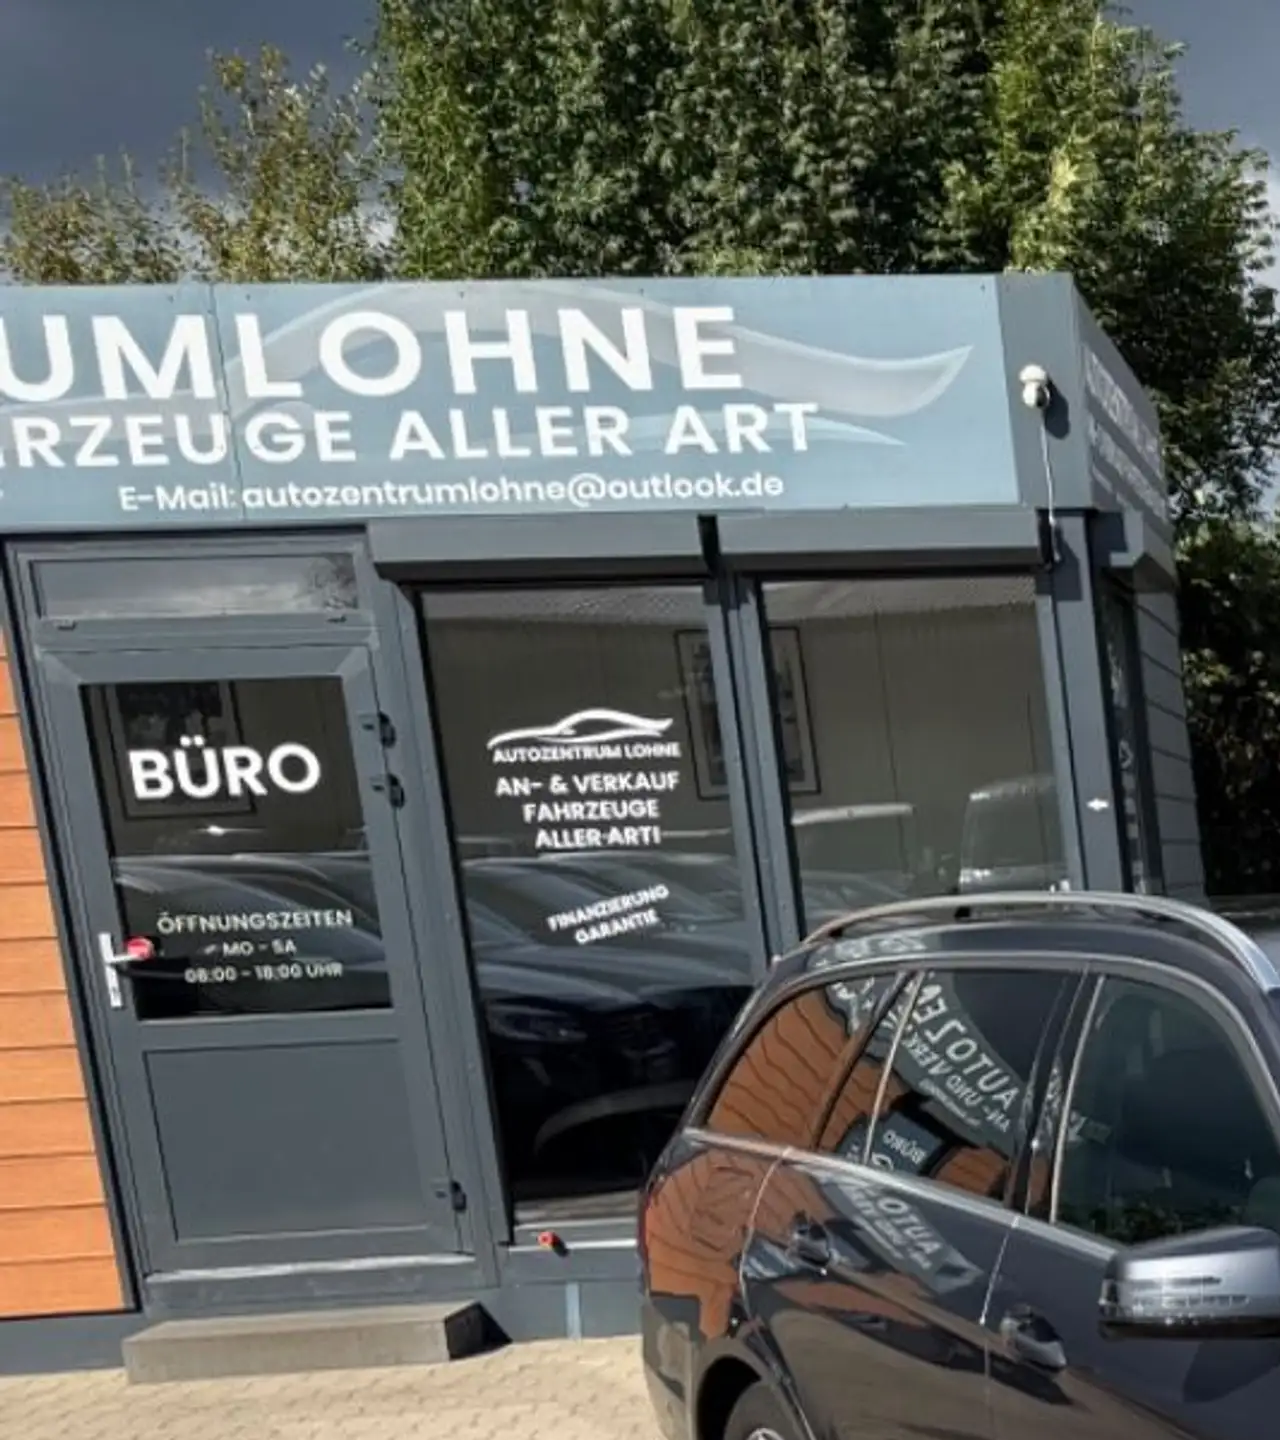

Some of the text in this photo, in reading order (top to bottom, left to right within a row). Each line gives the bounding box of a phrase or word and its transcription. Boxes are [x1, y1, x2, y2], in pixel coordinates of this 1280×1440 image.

[0, 402, 819, 468] RZEUGE ALLER ART
[118, 471, 785, 513] E-Mail: autozentrumlohne@outlook.de
[127, 733, 321, 800] BÜRO
[492, 742, 682, 764] AUTOZENTRUM LOHNE
[495, 771, 681, 797] AN- & VERKAUF
[522, 799, 661, 824] FAHRZEUGE
[534, 828, 602, 849] ALLER
[156, 908, 354, 936] ÖFFNUNGSZEITEN
[574, 908, 660, 946] GARANTIE
[305, 962, 344, 979] UHR
